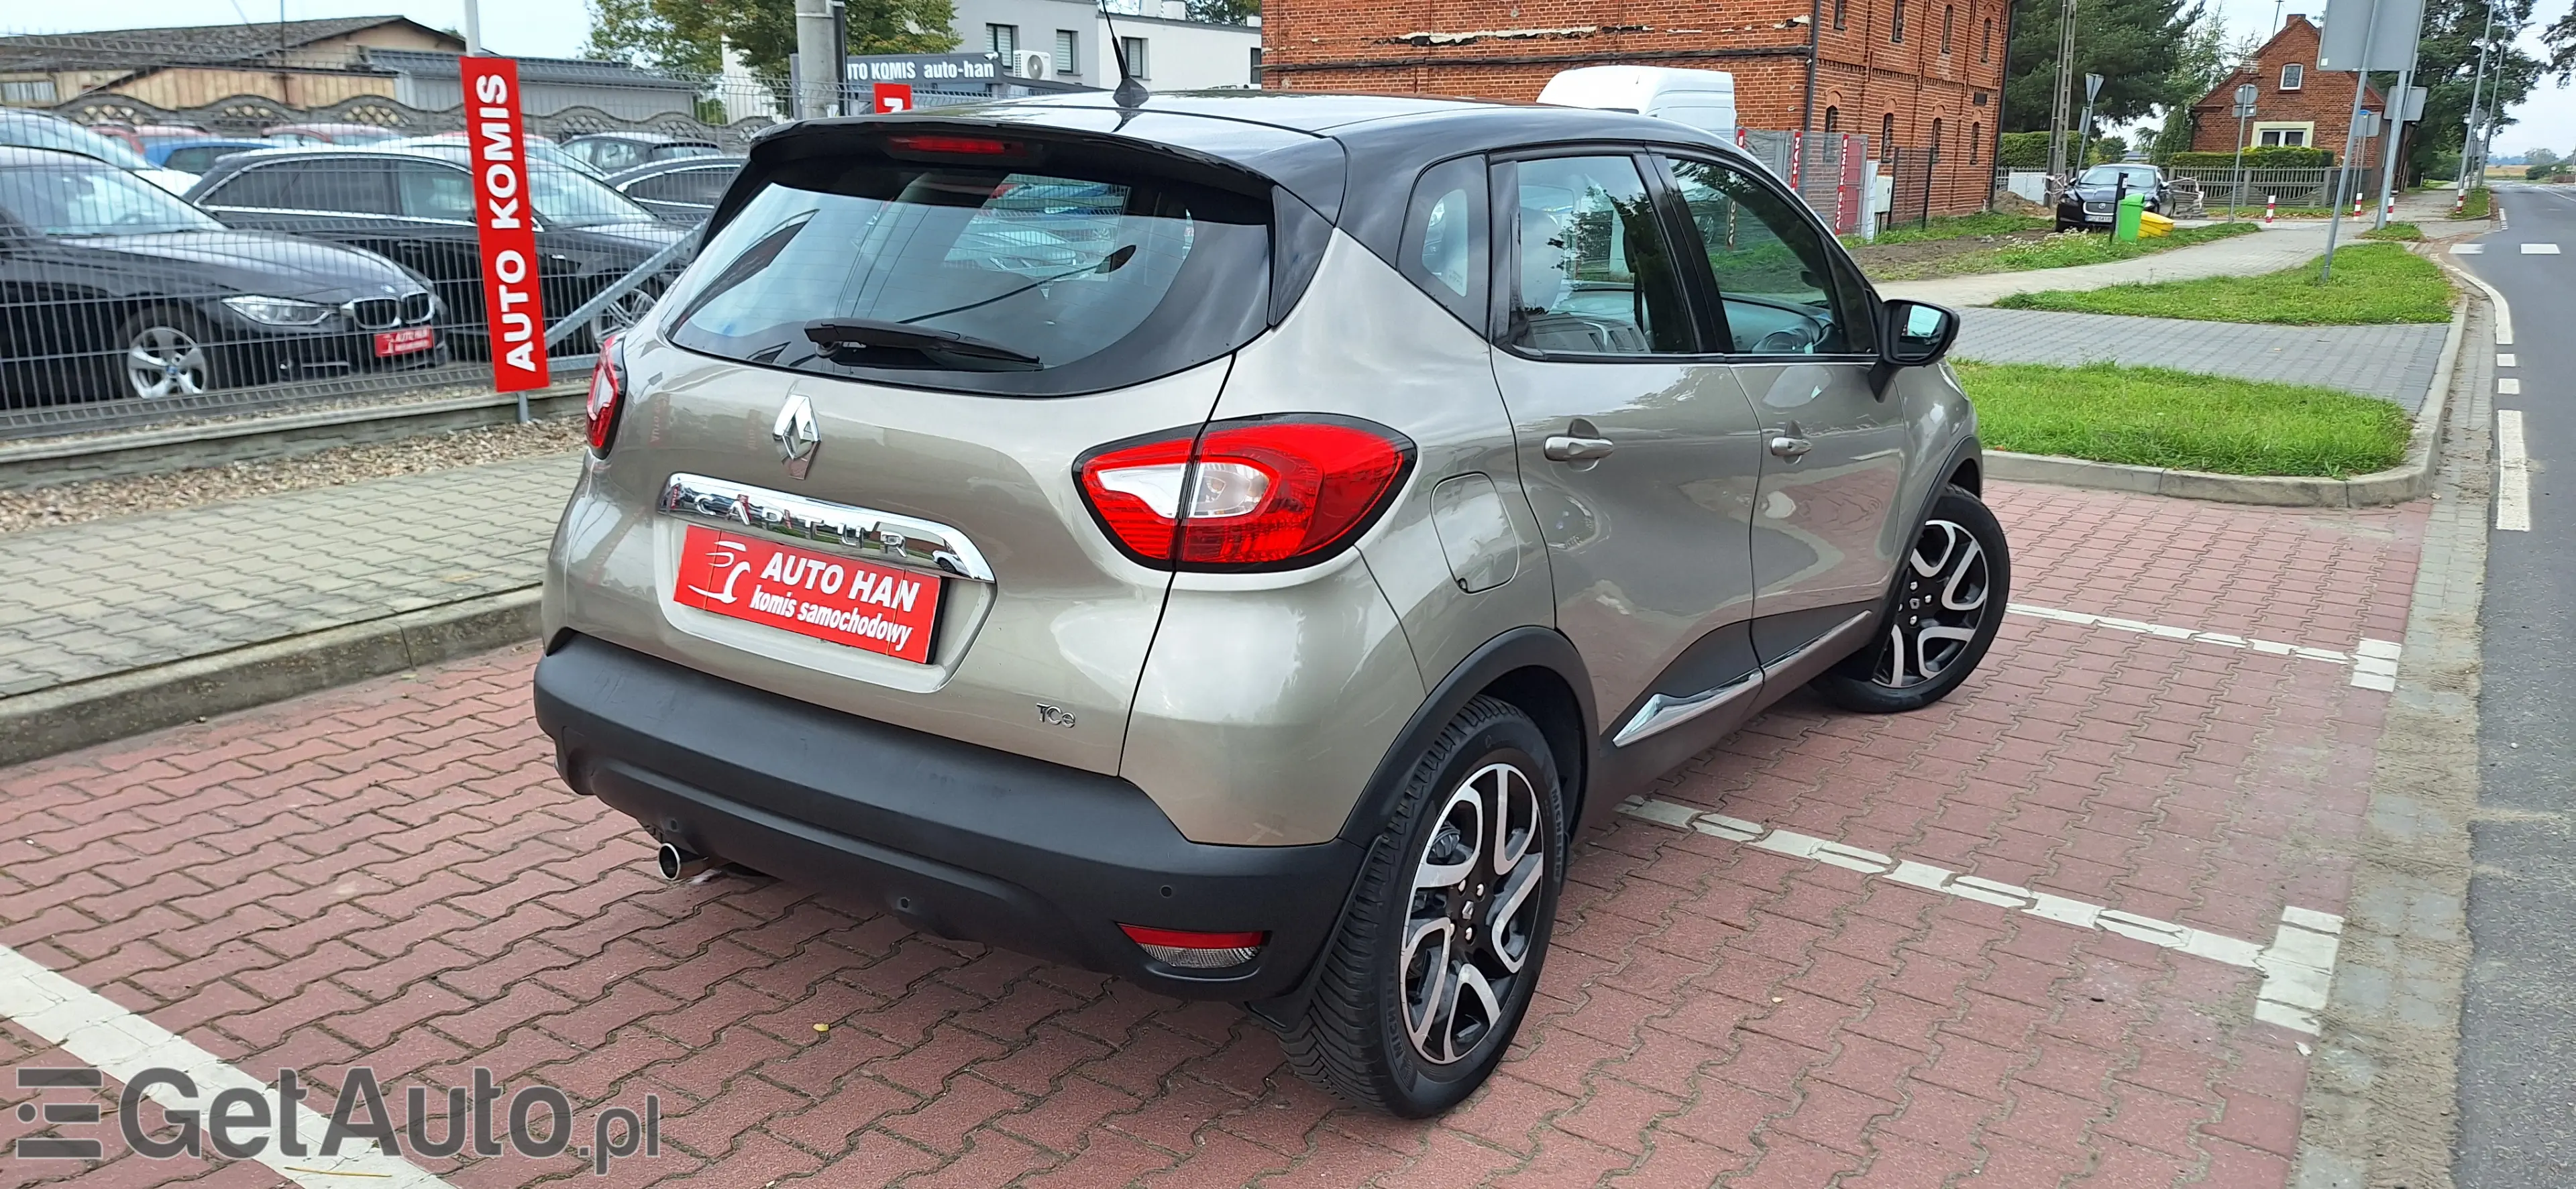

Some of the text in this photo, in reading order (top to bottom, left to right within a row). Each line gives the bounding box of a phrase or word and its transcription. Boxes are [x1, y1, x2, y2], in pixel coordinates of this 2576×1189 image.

[847, 60, 995, 80] TO KOMIS auto-han
[1839, 138, 1847, 186] KOMIS
[476, 74, 537, 372] AUTO KOMIS
[694, 494, 908, 558] CAPTUR
[760, 551, 920, 613] AUTO HAN
[749, 584, 912, 652] komis samochodowy
[1036, 702, 1076, 729] TCe
